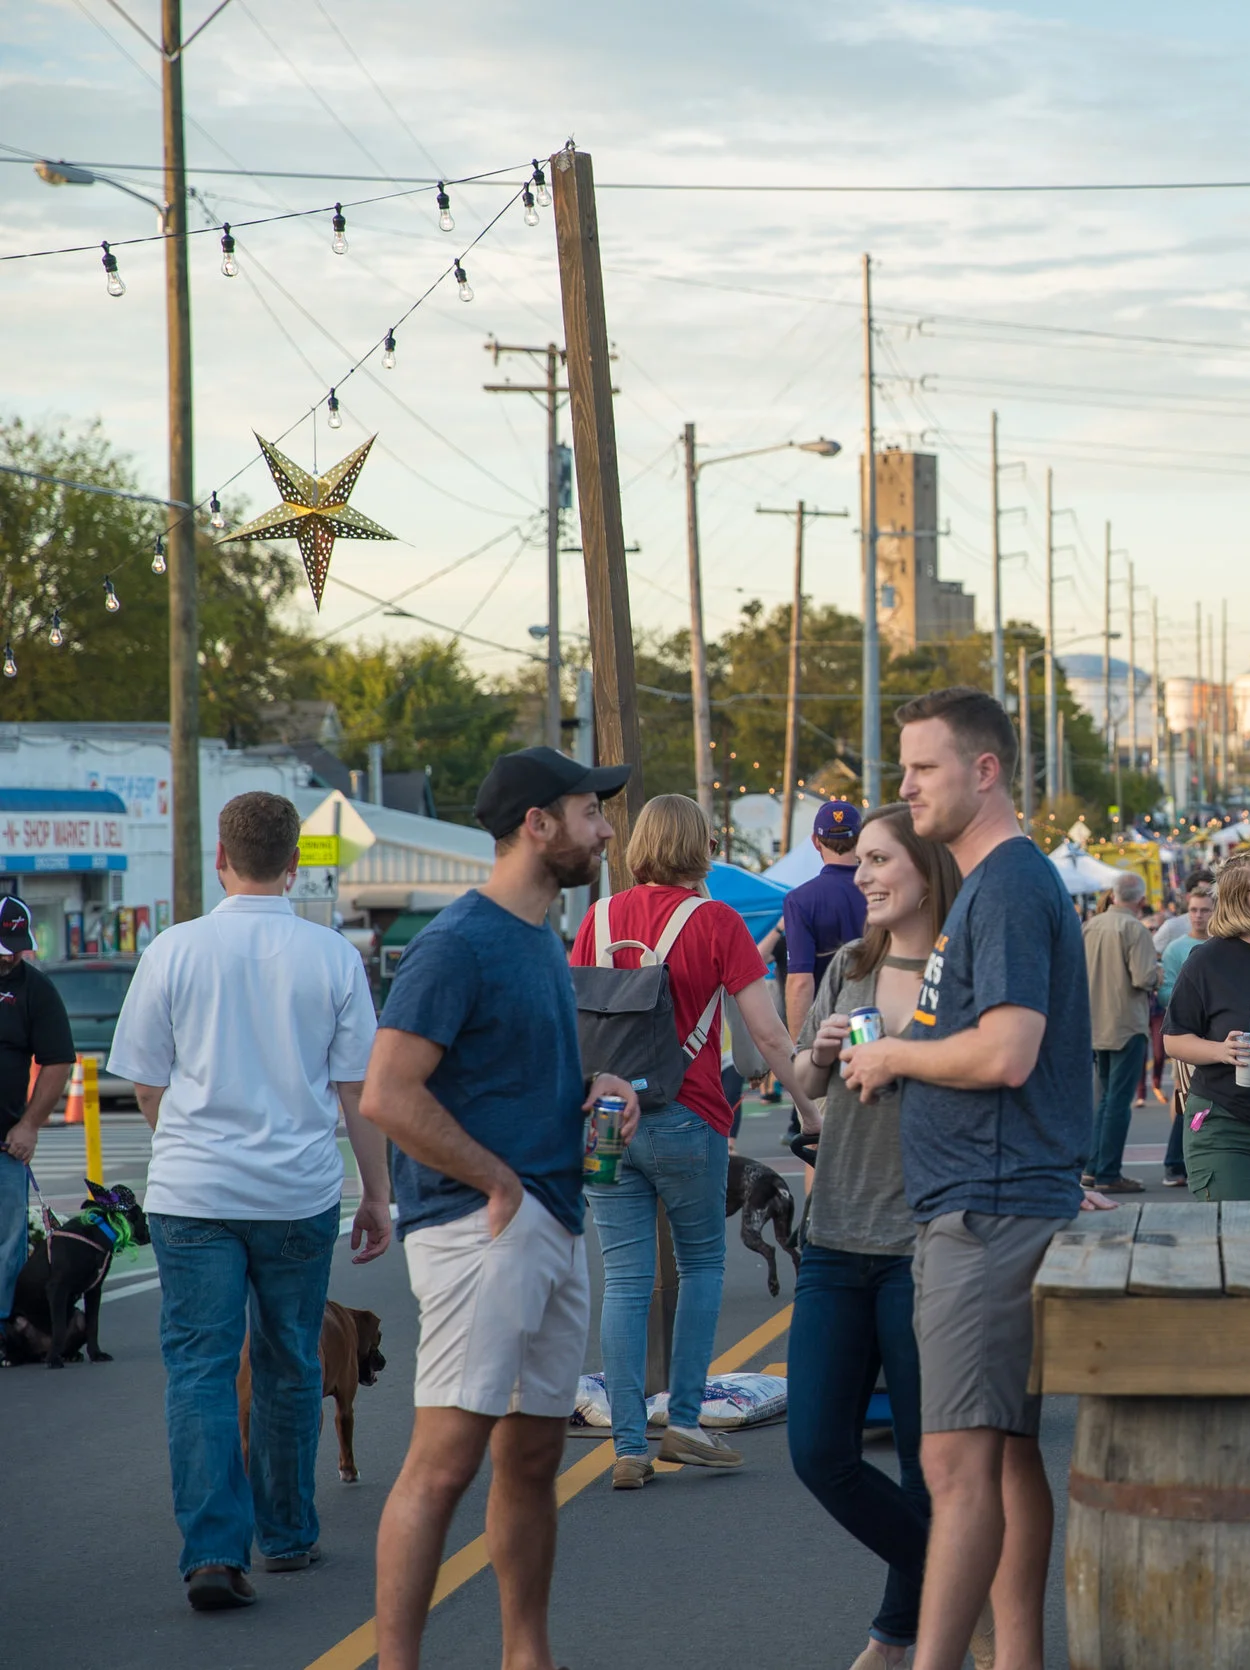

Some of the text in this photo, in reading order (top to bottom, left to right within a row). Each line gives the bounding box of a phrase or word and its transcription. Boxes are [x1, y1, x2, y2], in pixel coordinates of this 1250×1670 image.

[23, 820, 50, 847] SHOP
[53, 820, 91, 847] MARKET
[103, 820, 123, 847] DELI
